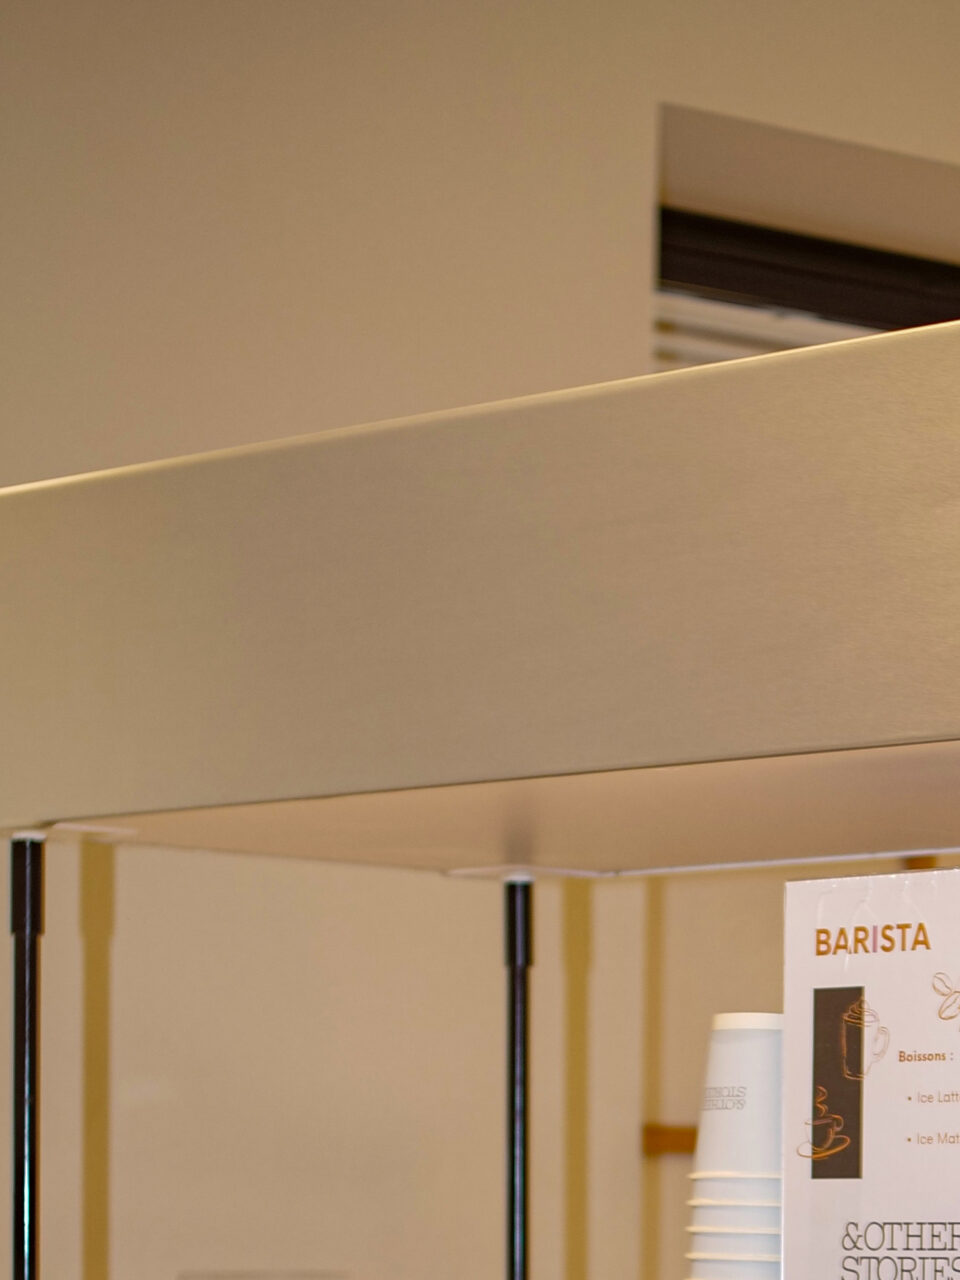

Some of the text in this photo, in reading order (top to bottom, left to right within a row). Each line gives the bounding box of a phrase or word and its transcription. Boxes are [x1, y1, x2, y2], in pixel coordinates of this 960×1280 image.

[815, 922, 931, 956] BARISTA
[898, 1050, 946, 1063] Boissons
[917, 1091, 934, 1104] Ice
[917, 1133, 934, 1145] Ice
